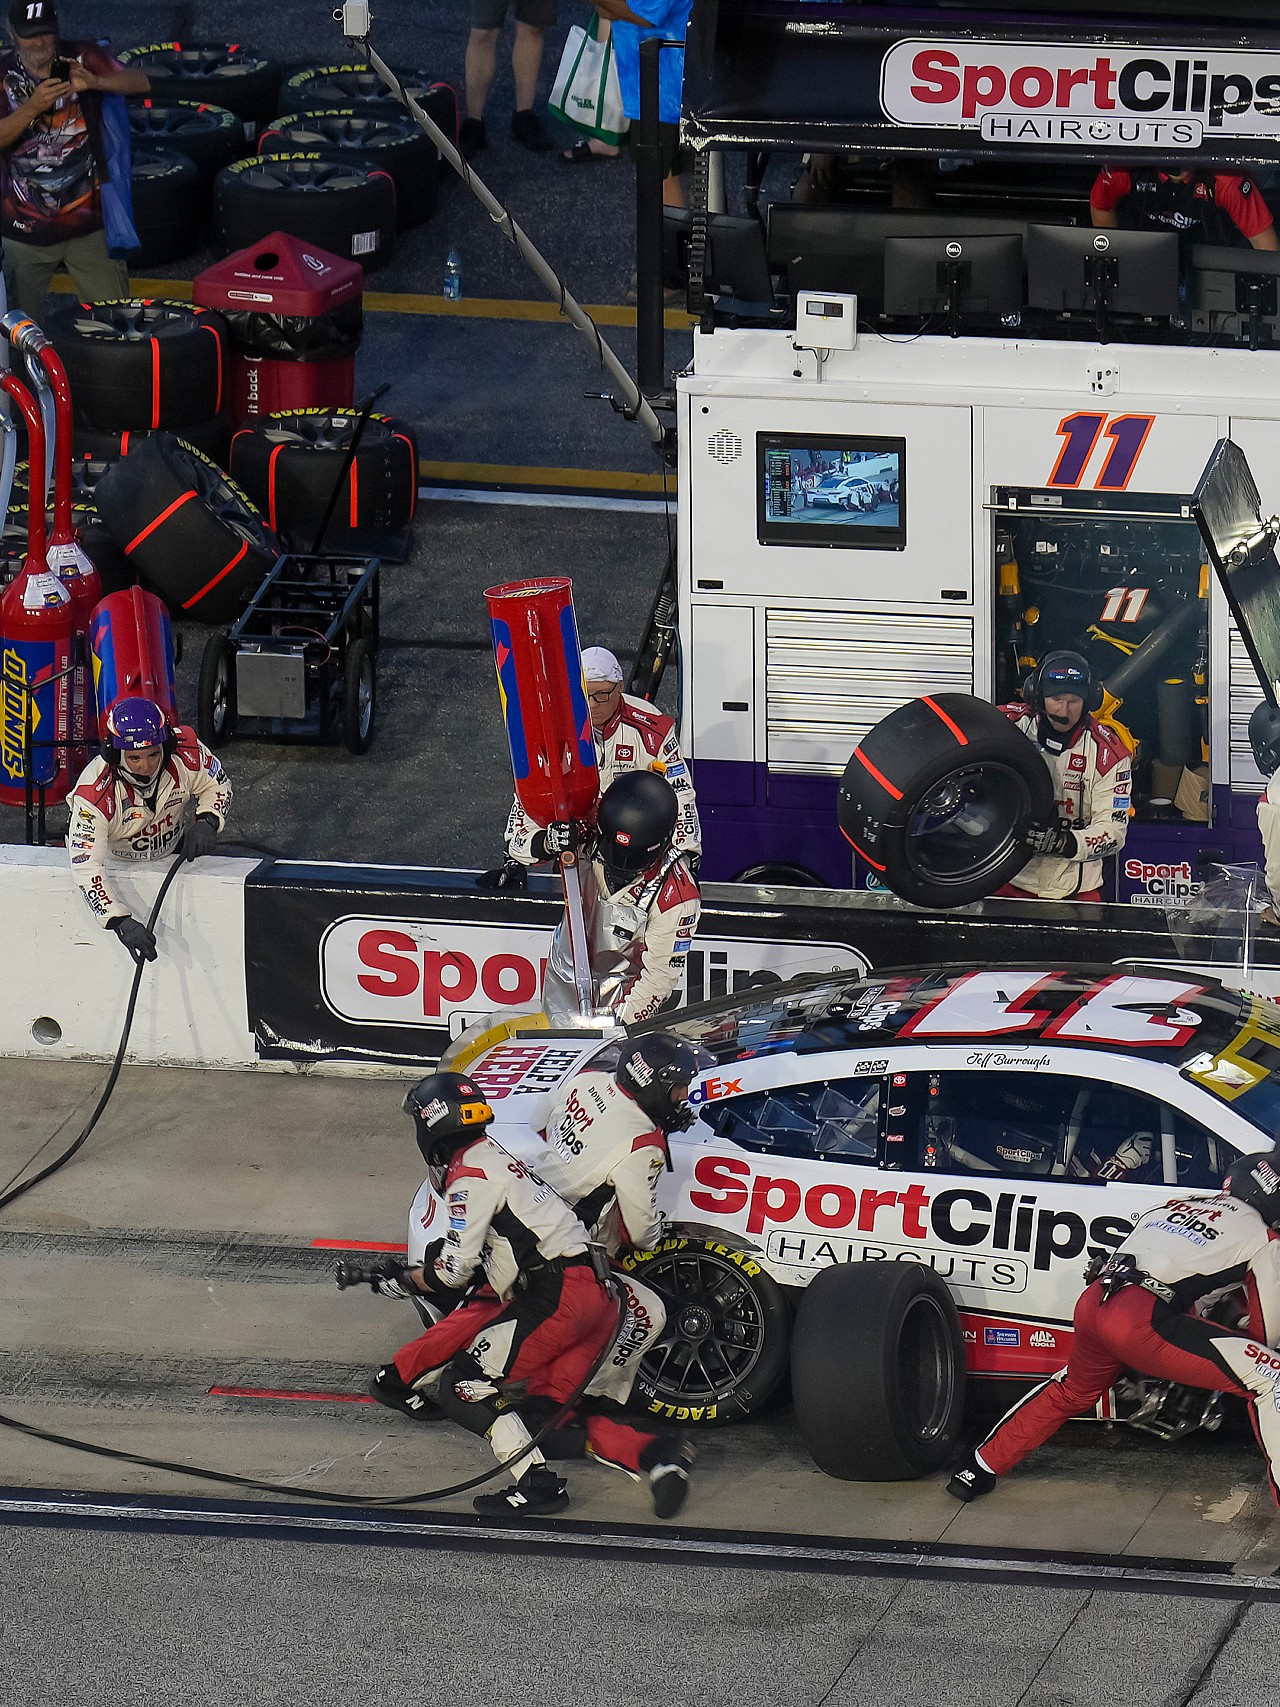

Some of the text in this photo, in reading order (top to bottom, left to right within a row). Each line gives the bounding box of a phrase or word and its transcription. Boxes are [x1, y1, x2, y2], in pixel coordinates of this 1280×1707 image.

[26, 2, 43, 20] 11
[990, 117, 1193, 144] HAIRCUTS
[246, 369, 258, 401] back
[1046, 412, 1156, 490] 11
[1100, 586, 1149, 622] 11
[132, 740, 152, 749] FedEx
[128, 813, 173, 842] ort
[683, 803, 695, 835] Clips
[1085, 830, 1112, 848] Sport
[1094, 839, 1118, 855] Clips
[1126, 860, 1190, 881] Sport
[91, 875, 114, 907] Sport
[1150, 879, 1200, 899] Clips
[634, 994, 662, 1022] Sport
[513, 1050, 582, 1096] HELP A
[966, 1052, 1051, 1070] Jeff Burroughs
[688, 1075, 744, 1105] dEx
[564, 1088, 594, 1132] Sport
[557, 1114, 584, 1156] Clips
[690, 1156, 1135, 1271] SportClips
[1166, 1199, 1223, 1222] Sport
[1166, 1212, 1220, 1241] Clips
[612, 1328, 650, 1368] Clips
[1029, 1330, 1056, 1343] MAC
[648, 1399, 719, 1421] EAGLE
